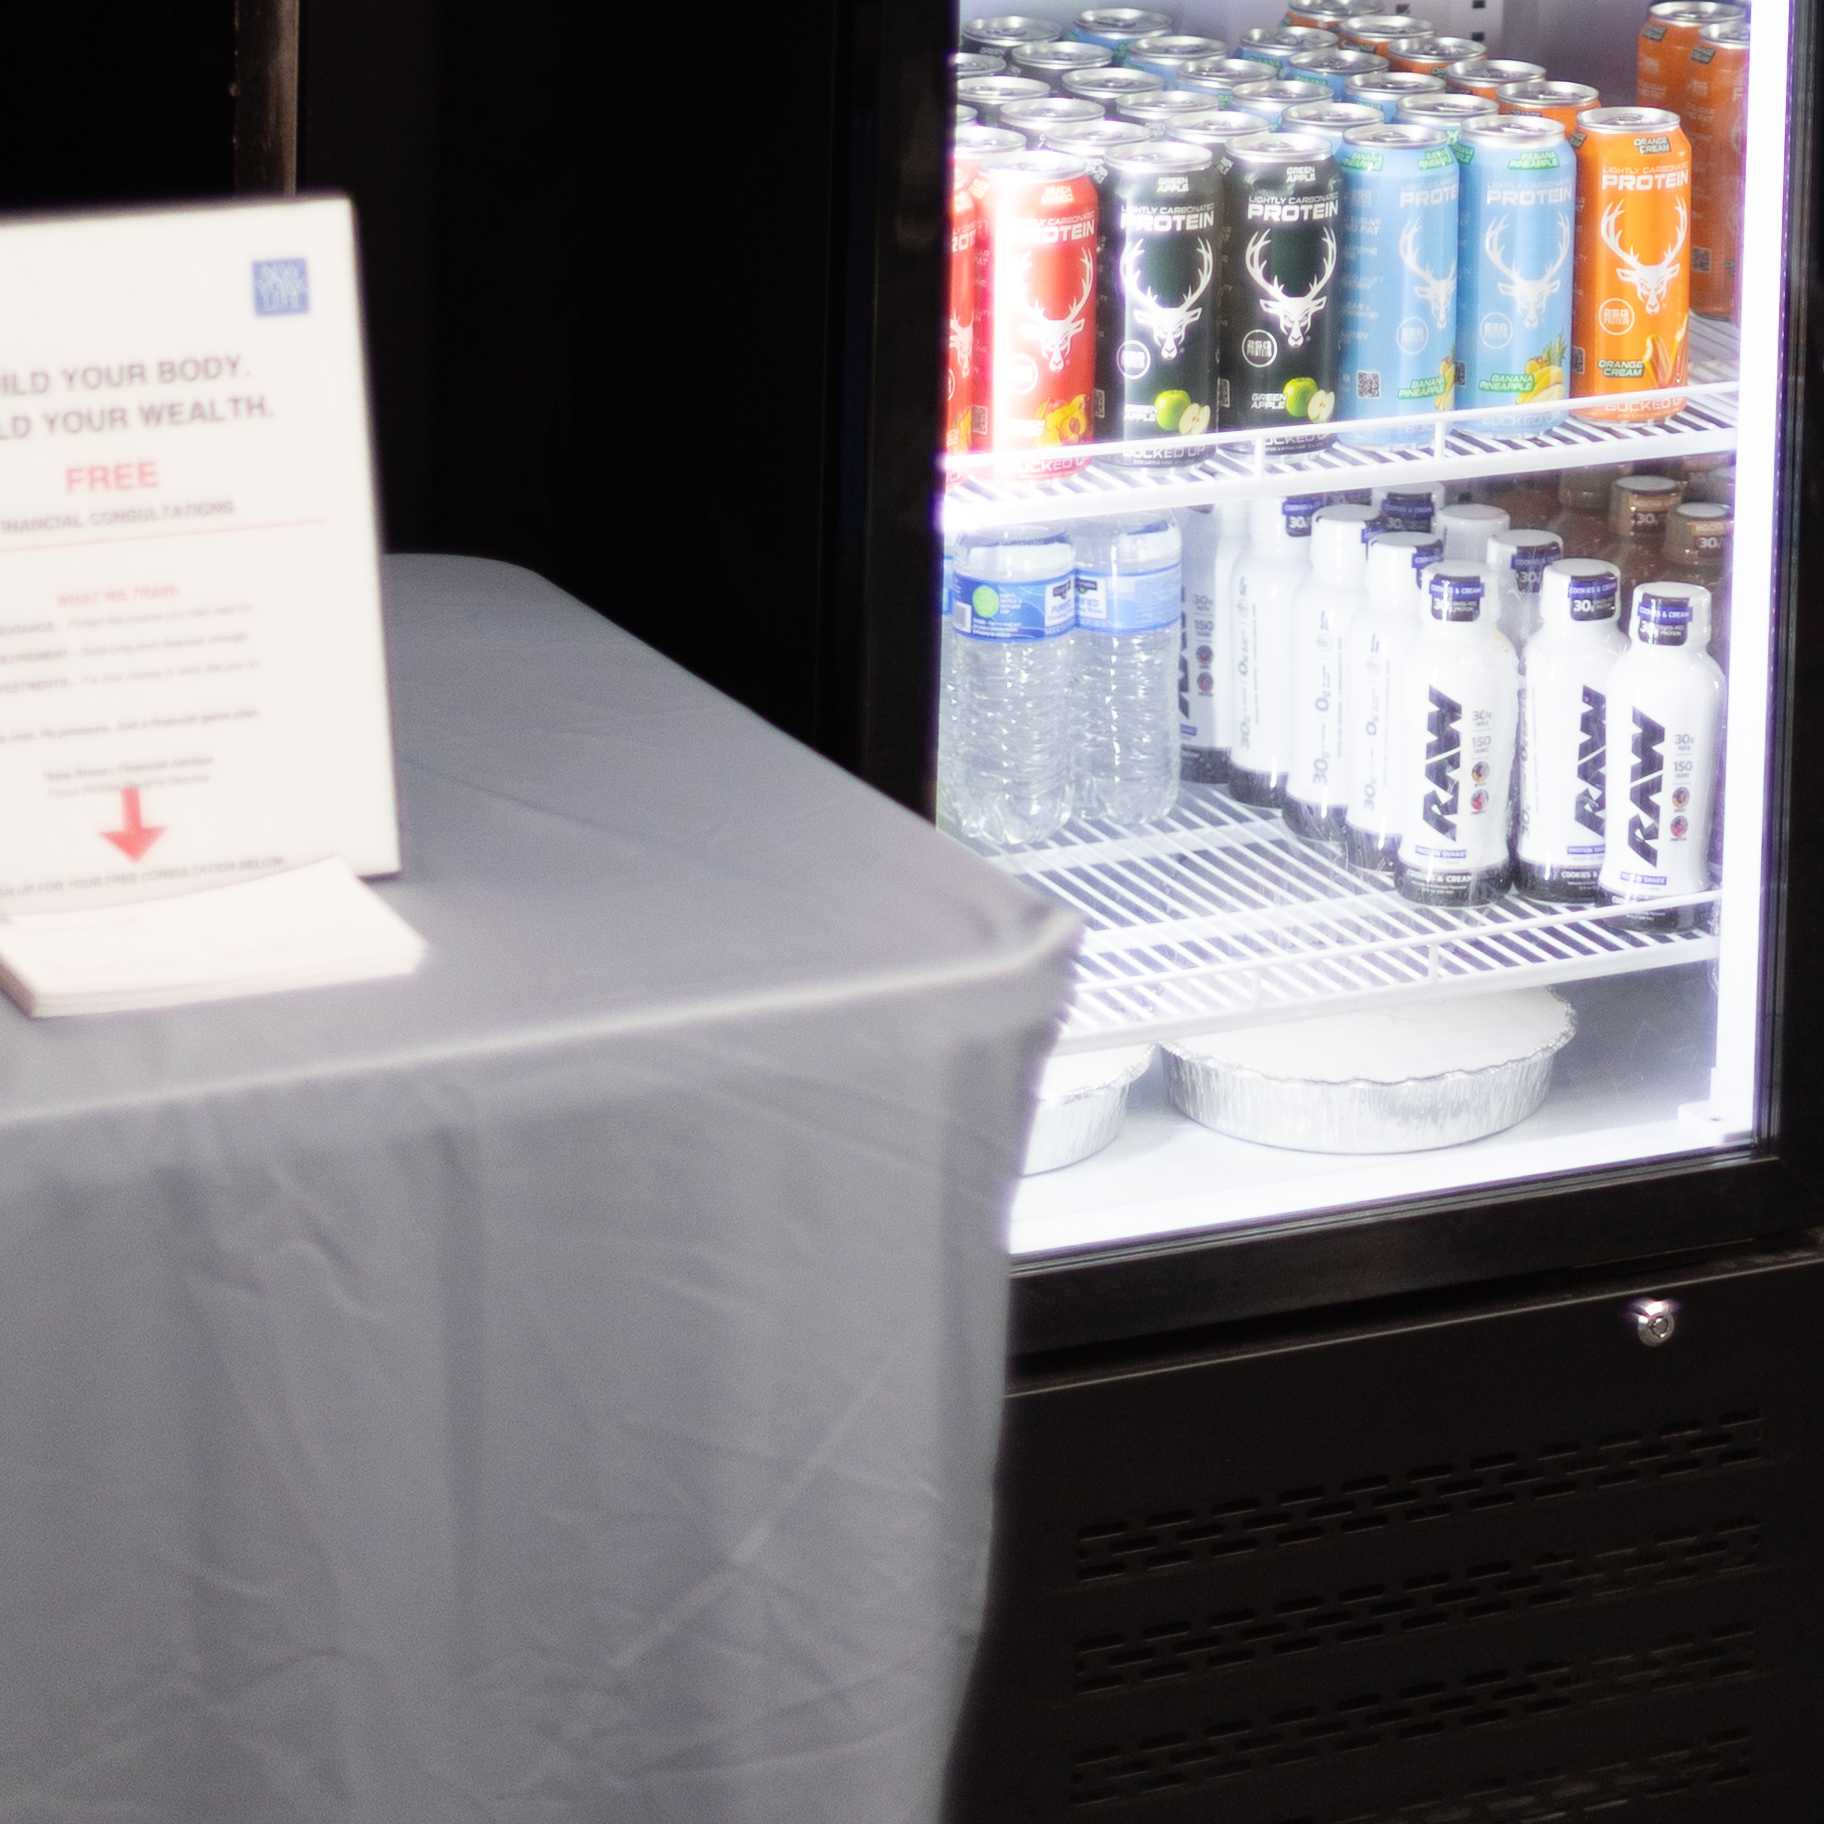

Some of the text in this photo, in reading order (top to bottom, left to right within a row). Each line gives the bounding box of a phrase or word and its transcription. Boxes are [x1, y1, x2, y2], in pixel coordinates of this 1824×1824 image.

[1632, 136, 1669, 146] ORANGE
[1638, 144, 1670, 154] CREAM
[1286, 165, 1315, 175] GREEN
[1285, 173, 1316, 183] APPLE
[1600, 170, 1690, 192] PROTEIN
[1485, 184, 1572, 206] PROTEIN
[1248, 197, 1286, 209] LIGHTLY
[1247, 198, 1339, 222] PROTEIN
[1120, 210, 1215, 233] PROTEIN
[1597, 360, 1643, 370] ORANGE
[61, 362, 148, 392] YOUR
[157, 354, 252, 386] BODY.
[1490, 373, 1534, 383] BANANA
[1603, 368, 1643, 378] CREAM
[1251, 392, 1286, 401] GREEN
[1250, 400, 1285, 410] APPLE
[44, 406, 129, 436] YOUR
[138, 396, 276, 428] WEALTH.
[64, 460, 161, 494] FREE
[1422, 683, 1463, 842] RAW
[1673, 760, 1693, 772] 150
[1627, 705, 1665, 868] RAW
